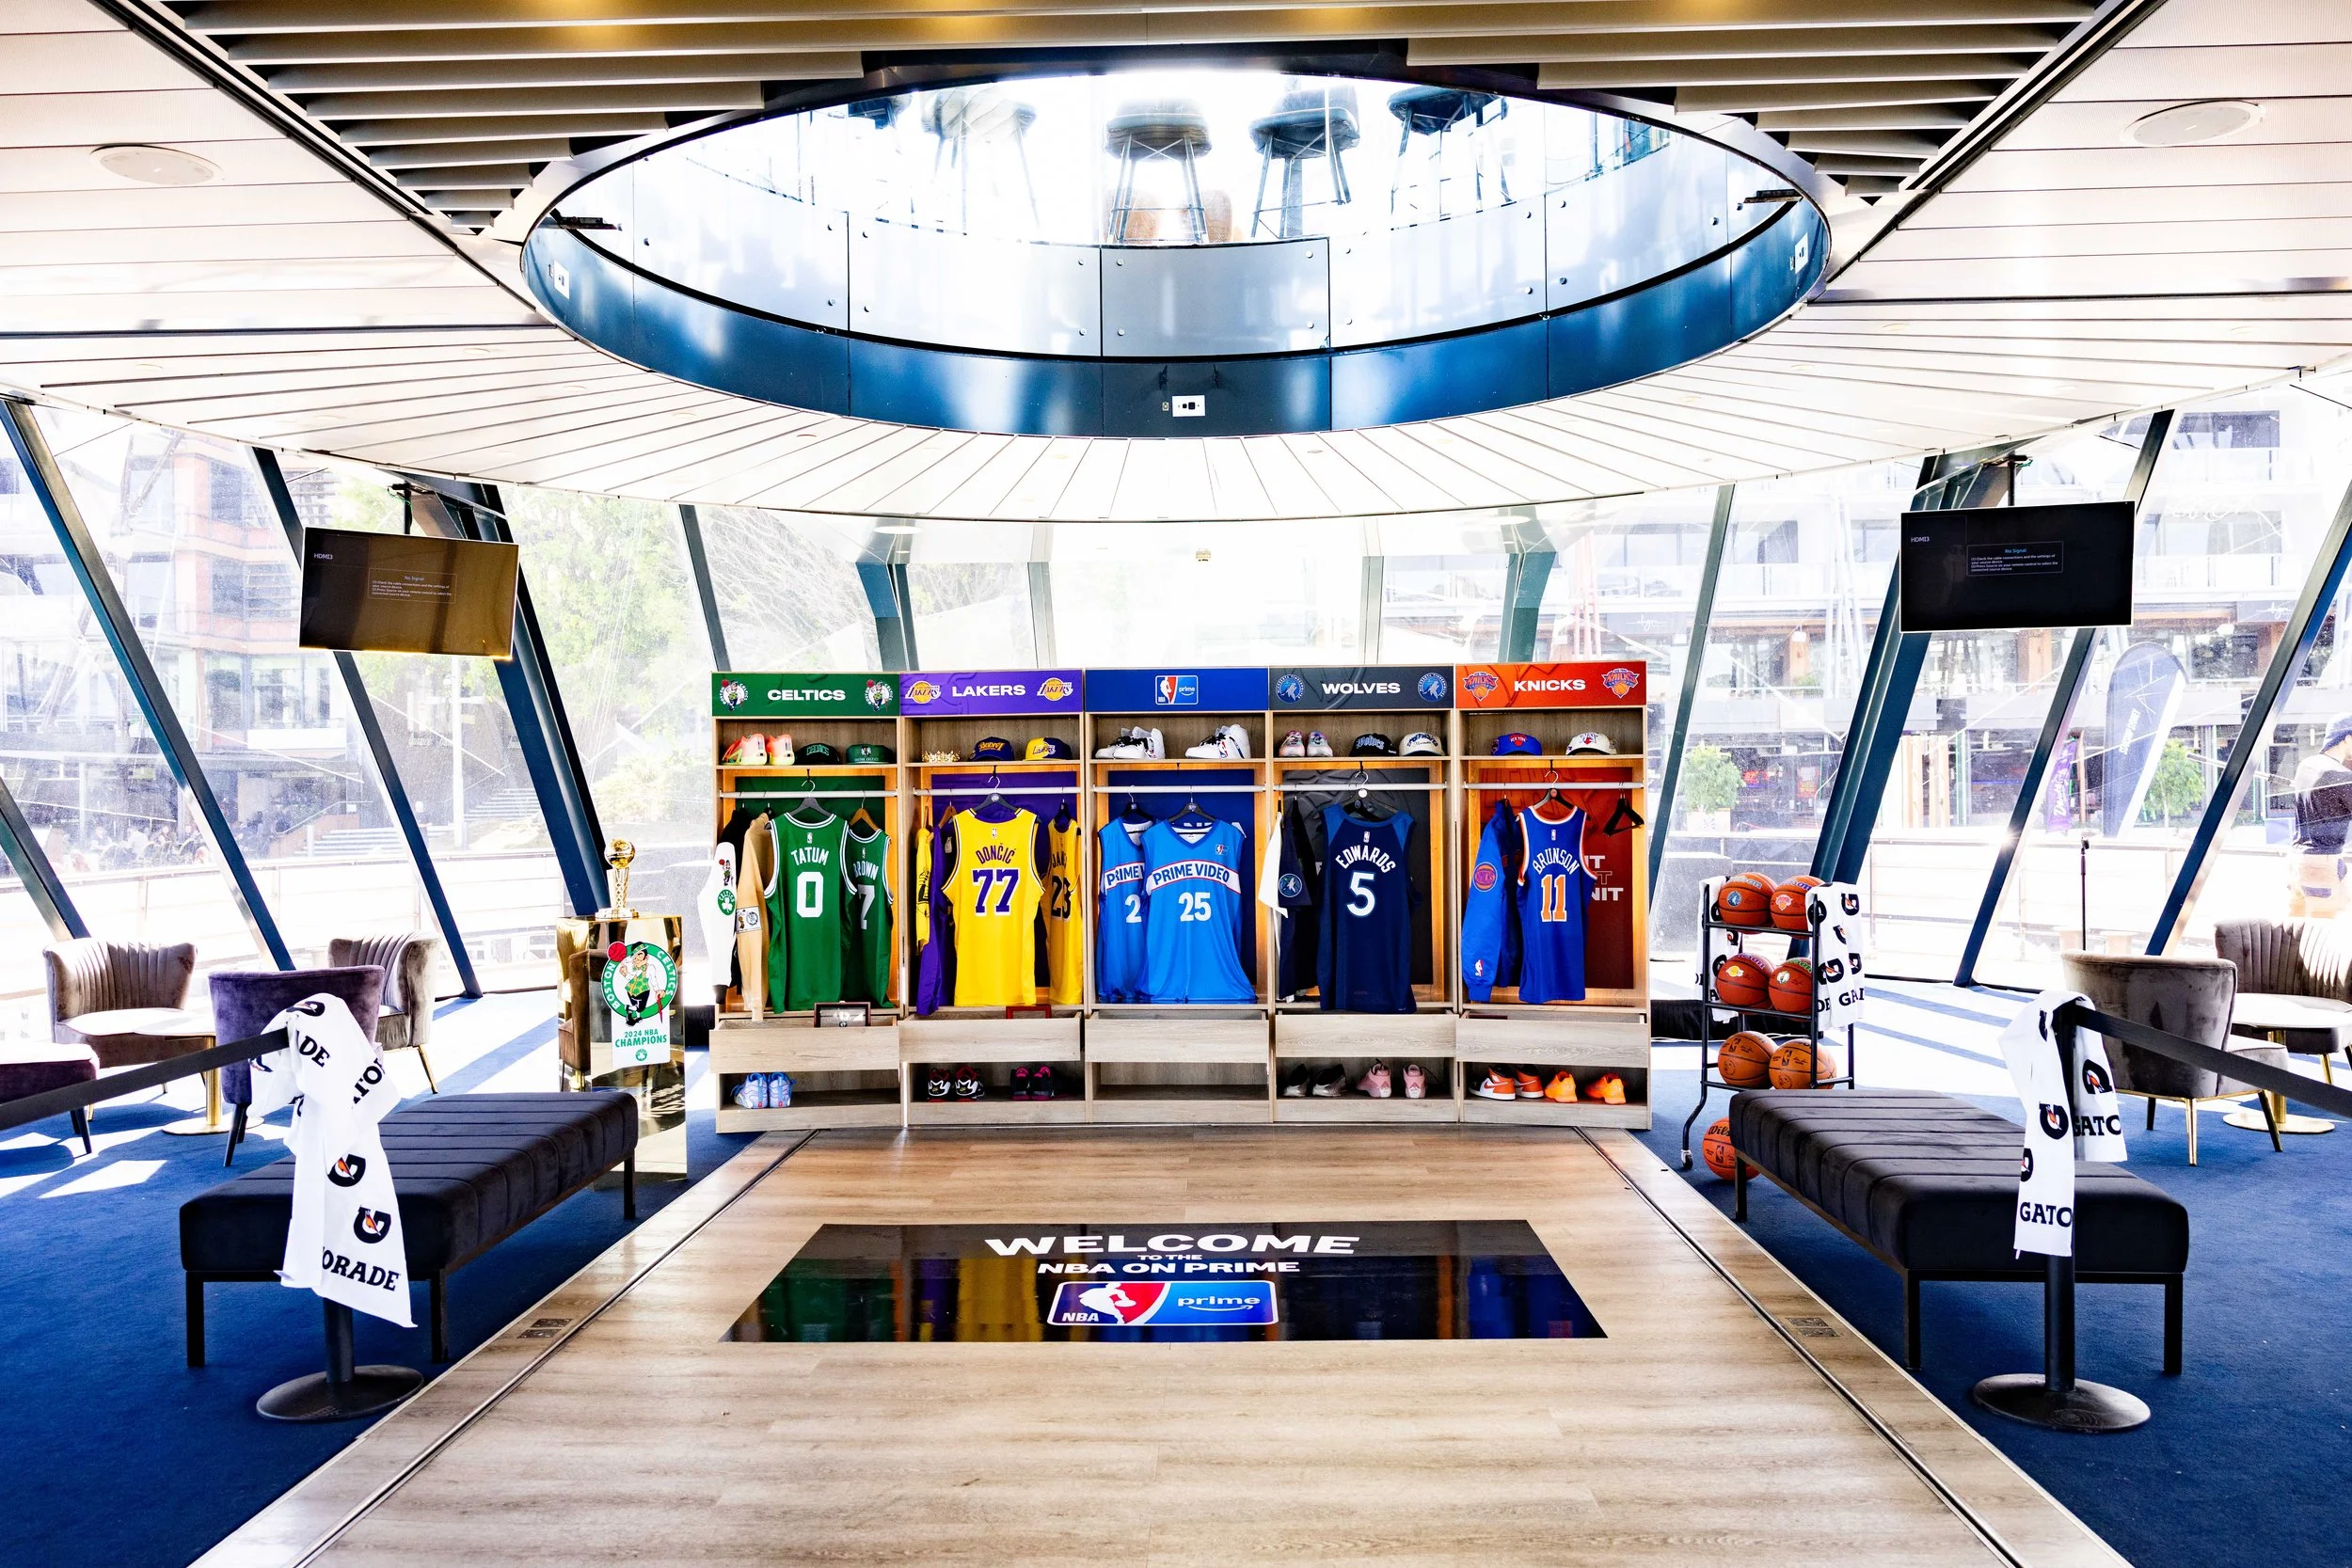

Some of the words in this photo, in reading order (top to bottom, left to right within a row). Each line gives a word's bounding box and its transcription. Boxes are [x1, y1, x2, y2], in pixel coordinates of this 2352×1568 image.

[767, 689, 846, 701] CELTICS
[952, 685, 1026, 697] LAKERS
[1322, 683, 1401, 694] WOLVES
[1514, 679, 1586, 691] KNICKS
[790, 847, 830, 866] TATUM
[975, 842, 1017, 864] DONČIĆ
[1335, 845, 1396, 874] EDWARDS
[1533, 847, 1581, 875] BRUNSON
[852, 861, 880, 881] BROWN
[1106, 865, 1139, 886] PRIME
[1152, 863, 1193, 885] PRIME
[1194, 863, 1230, 883] VIDEO
[796, 871, 824, 918] 0
[971, 867, 1021, 917] 77
[1051, 875, 1072, 920] 23
[1346, 870, 1375, 917] 5
[1540, 874, 1567, 923] 11
[857, 884, 876, 930] 7
[1178, 892, 1212, 922] 25
[602, 961, 621, 1009] BOSTON
[657, 950, 677, 998] CELTICS
[614, 1034, 667, 1048] CHAMPIONS
[624, 1029, 643, 1038] 2024
[2020, 1201, 2073, 1227] GATO
[984, 1234, 1360, 1256] WELCOME
[1037, 1262, 1116, 1274] NBA
[1122, 1262, 1181, 1274] ON
[1183, 1261, 1300, 1274] PRIME
[1178, 1294, 1261, 1307] prime
[1061, 1311, 1100, 1323] NBA
